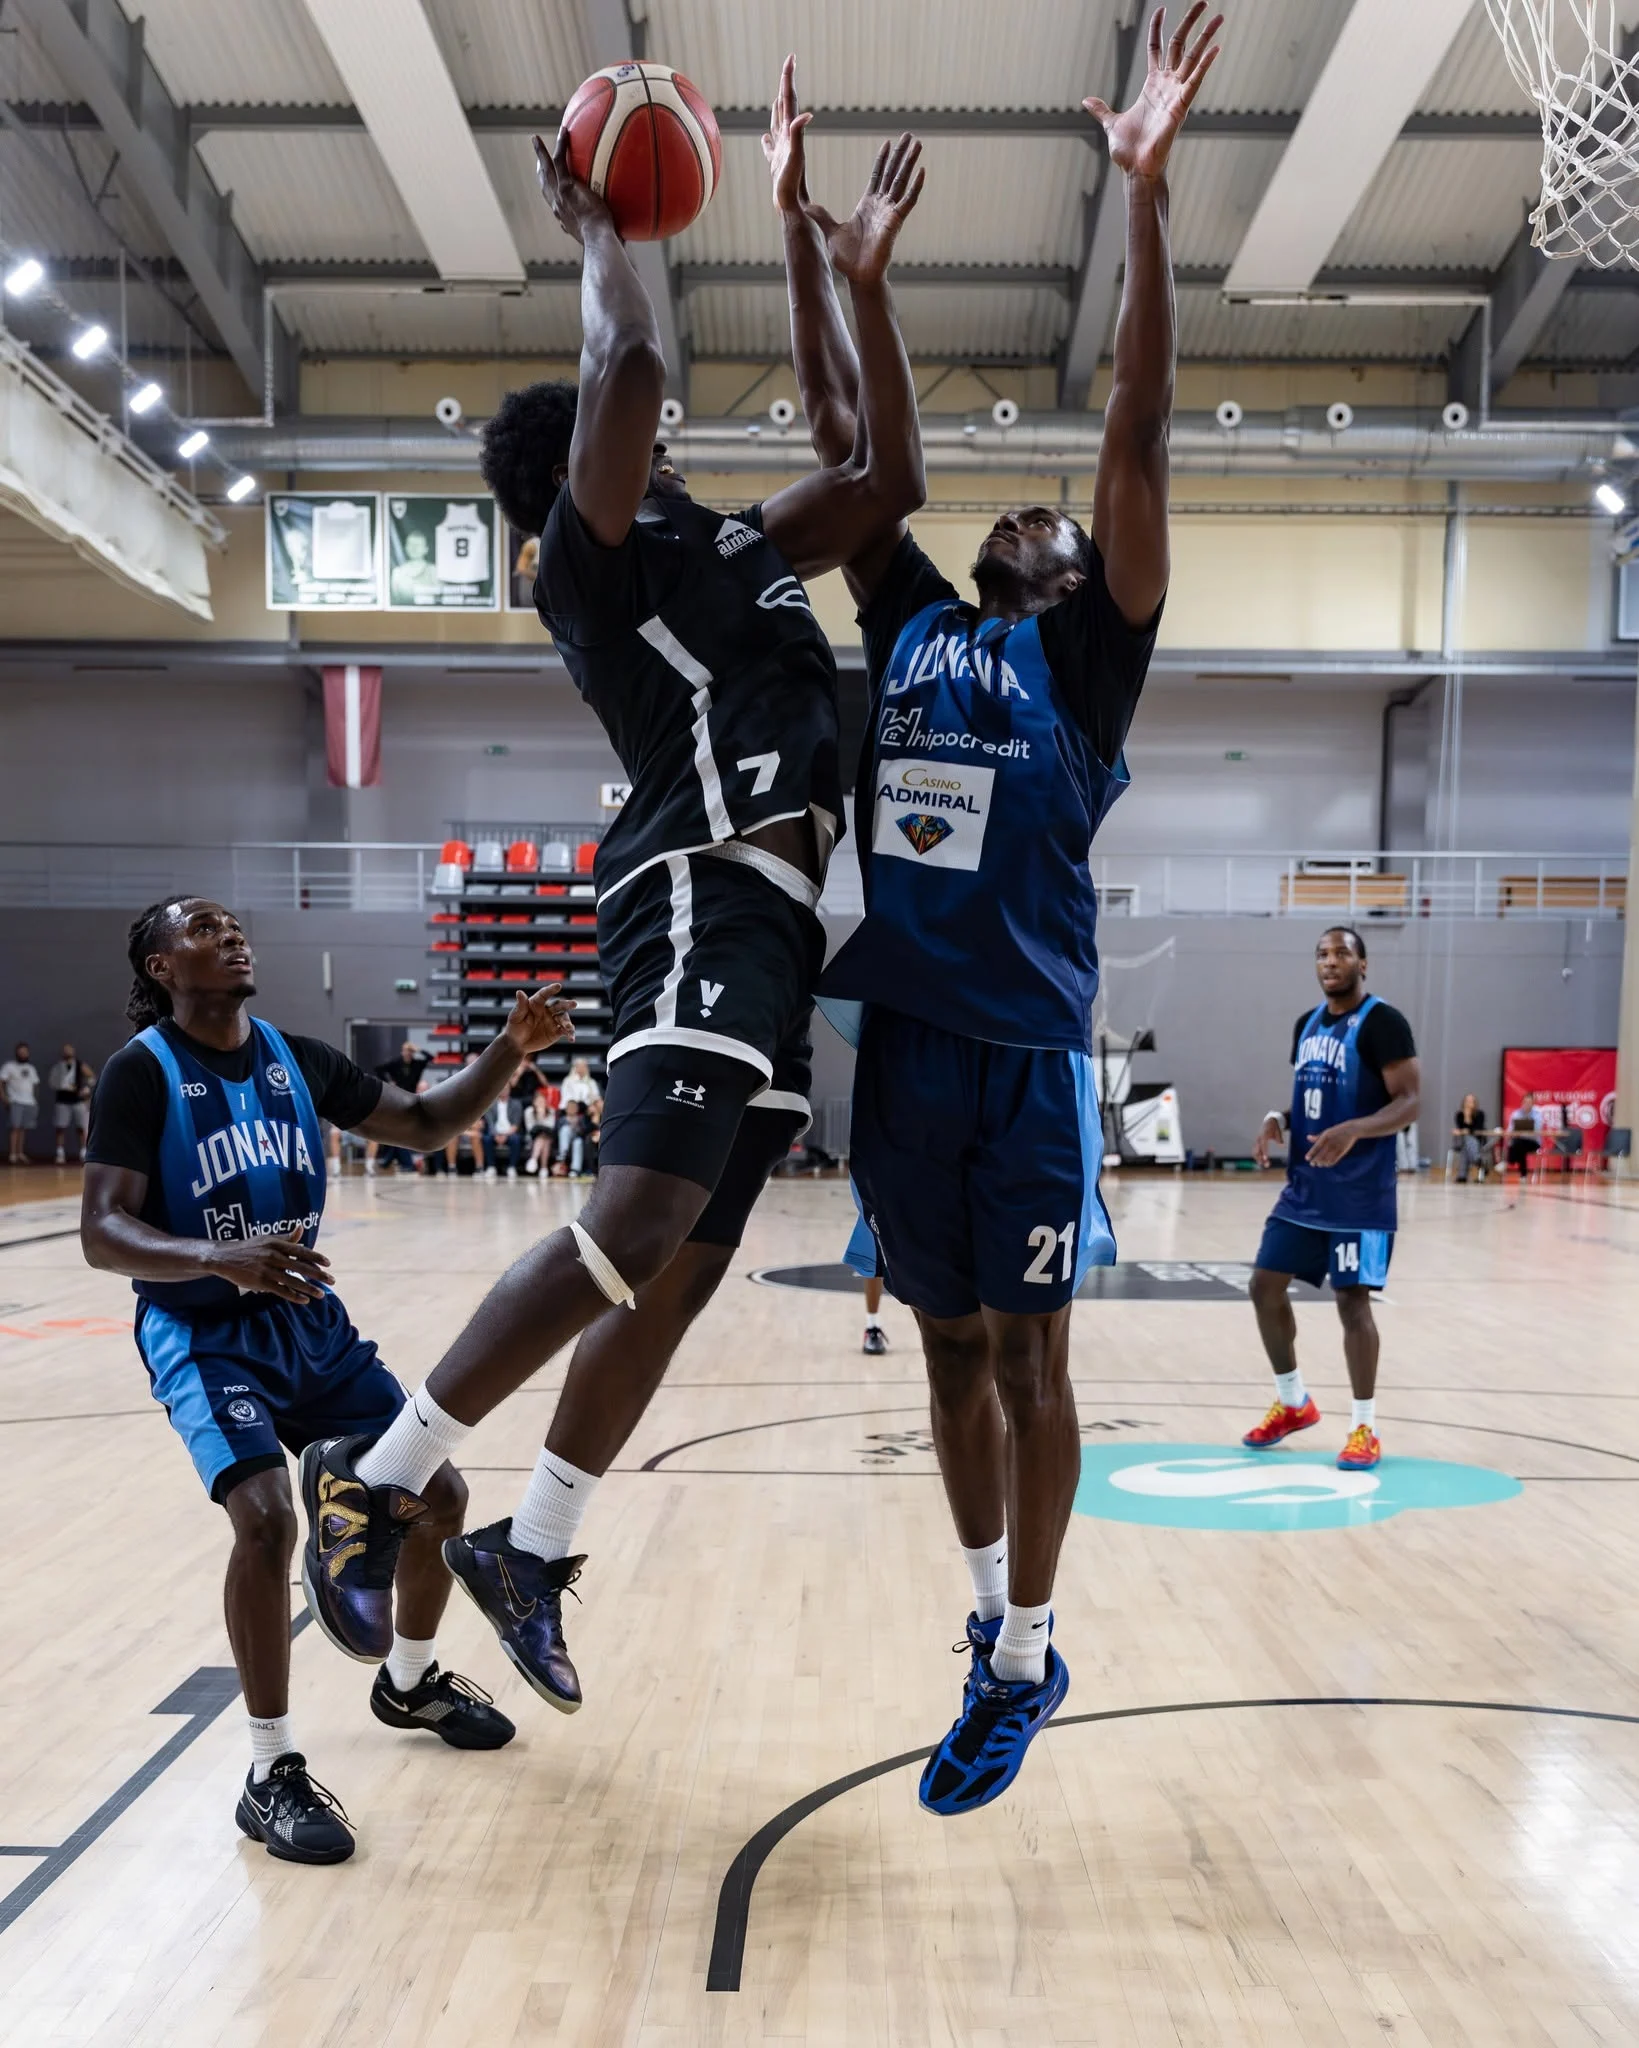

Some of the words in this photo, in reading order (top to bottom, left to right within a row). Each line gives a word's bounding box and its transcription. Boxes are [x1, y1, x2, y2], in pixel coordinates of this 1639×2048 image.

[456, 537, 469, 557] 8
[886, 633, 1030, 700] JONAVA
[912, 728, 1031, 759] hipocredit
[736, 750, 781, 796] 7
[902, 768, 962, 790] CASINO
[612, 787, 624, 801] K
[877, 784, 980, 814] ADMIRAL
[1294, 1035, 1346, 1072] JONAVA
[1304, 1088, 1322, 1120] 19
[191, 1119, 316, 1198] JONAVA
[1023, 1221, 1076, 1284] 21
[1335, 1242, 1359, 1272] 14
